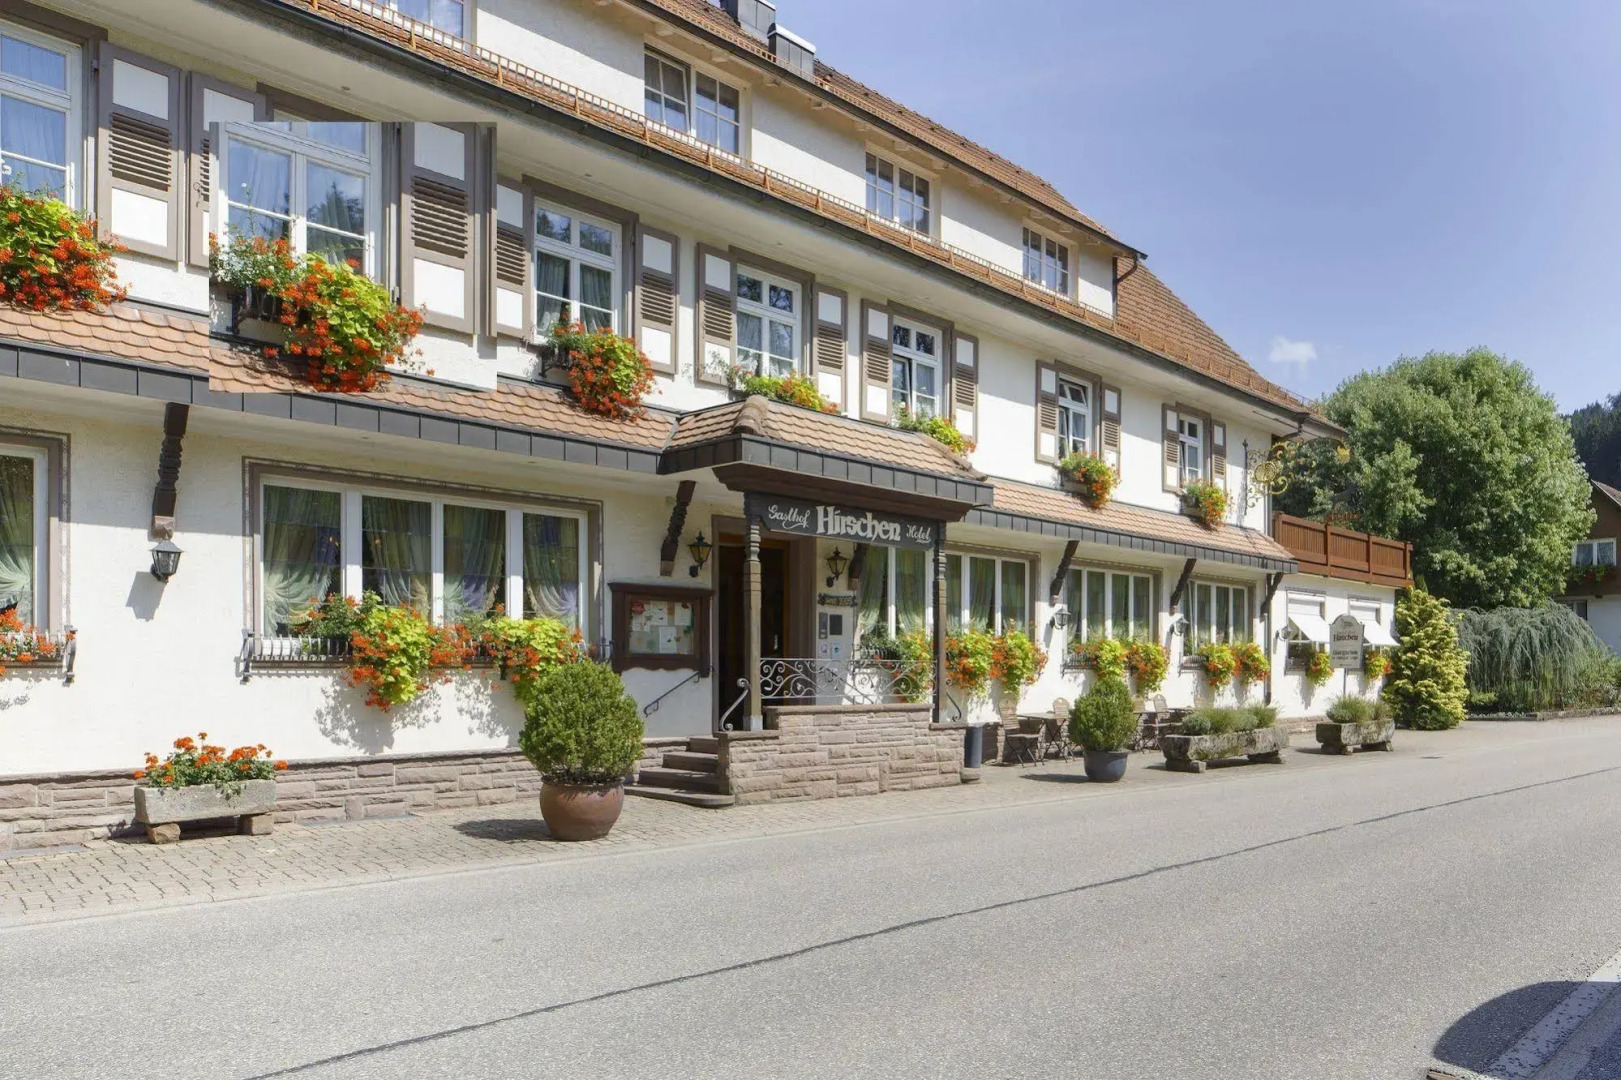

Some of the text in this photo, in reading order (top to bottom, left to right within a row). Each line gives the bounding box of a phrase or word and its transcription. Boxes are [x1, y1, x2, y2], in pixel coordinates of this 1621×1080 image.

[768, 504, 932, 543] Gasthof Hirschen Hotel
